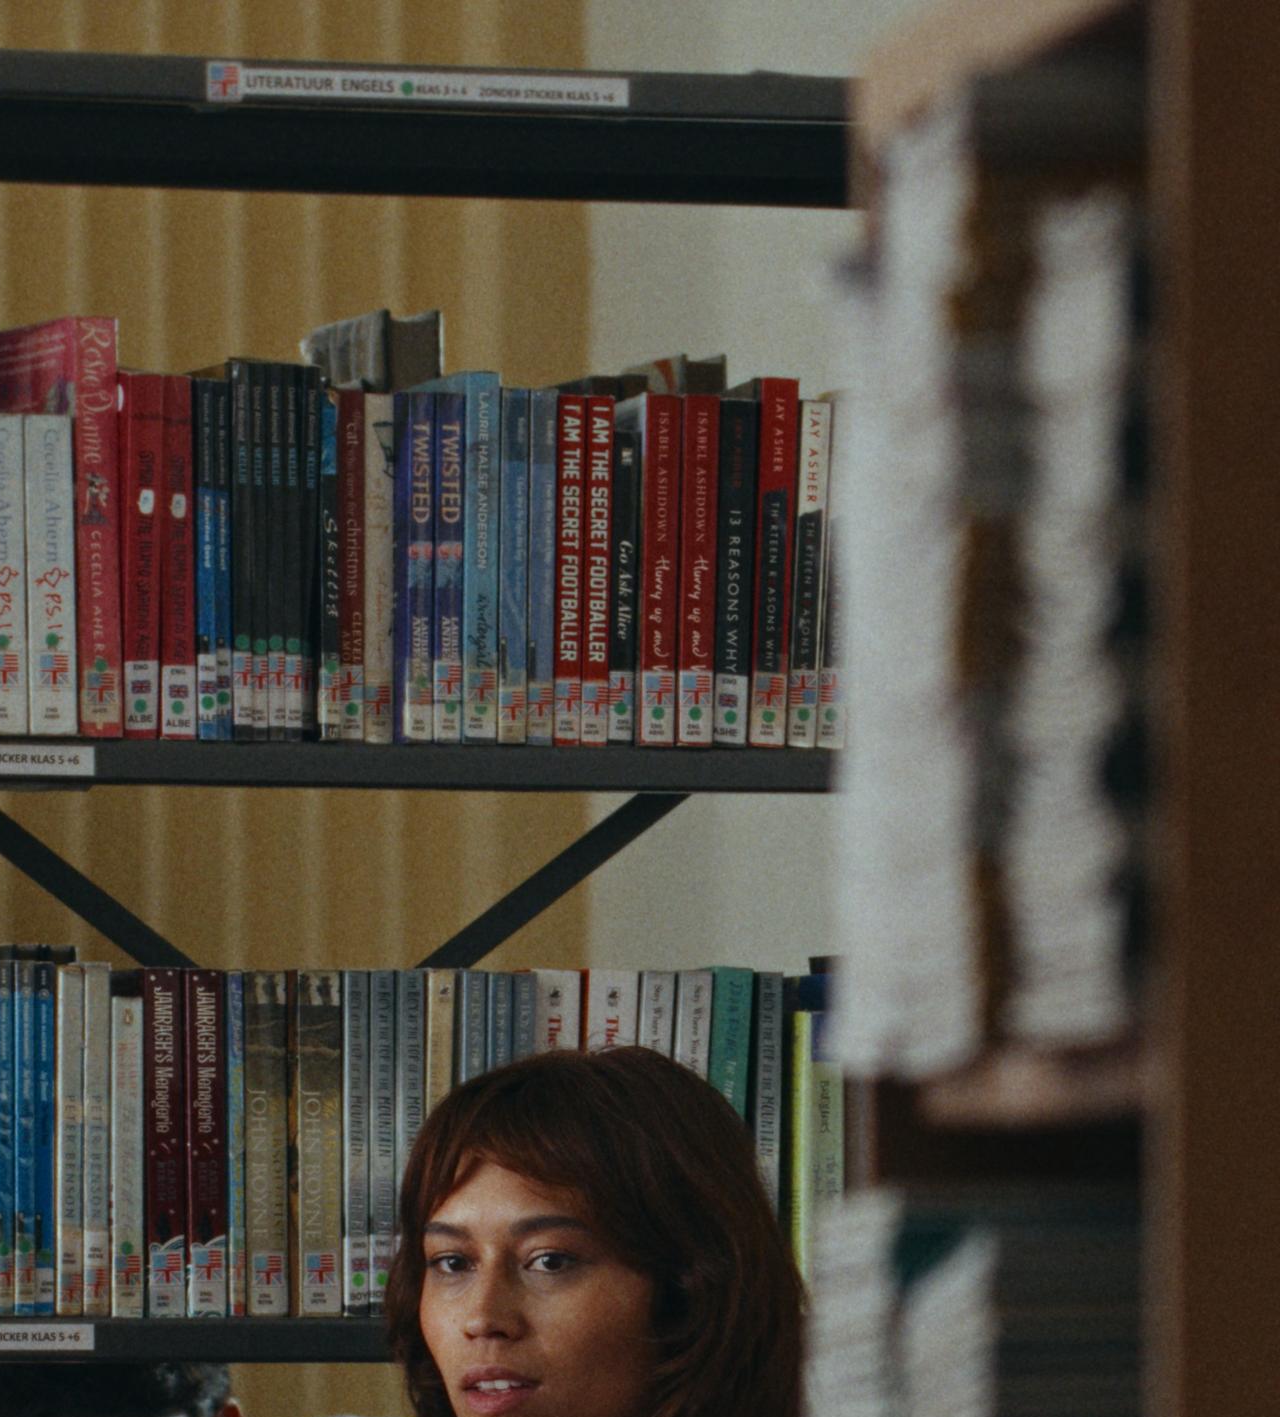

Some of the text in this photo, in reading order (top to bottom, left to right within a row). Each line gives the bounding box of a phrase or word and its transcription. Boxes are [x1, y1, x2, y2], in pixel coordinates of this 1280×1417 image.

[246, 75, 332, 89] LITERATUUR
[341, 79, 394, 93] ENGELS
[80, 322, 115, 464] Rosie Dunne
[563, 416, 580, 442] AM
[591, 416, 609, 443] AM
[772, 398, 787, 472] JAY ASHER
[412, 423, 429, 523] TWISTED
[441, 423, 460, 523] TWISTED
[476, 392, 490, 569] LAURIE HALSE ANDERSON
[562, 449, 580, 480] THE
[591, 449, 609, 480] THE
[562, 487, 580, 550] SECRET
[590, 487, 609, 550] SECRET
[649, 412, 670, 657] ISABEL ASHDOWN Hurry up and
[560, 555, 579, 661] FOOTBALLER
[589, 556, 608, 661] FOOTBALLER
[616, 540, 632, 639] Go Ask Alice
[724, 510, 742, 672] 13 REASONS WHY
[128, 714, 153, 723] ALBE
[166, 719, 191, 728] ALBE
[30, 754, 55, 765] KLAS
[58, 755, 64, 765] 5
[150, 1067, 174, 1133] Menagerie
[248, 1089, 268, 1238] JOHN BOYNE
[301, 1090, 321, 1239] JOHN BOYNE
[31, 1332, 56, 1341] KLAS
[59, 1332, 65, 1341] 5
